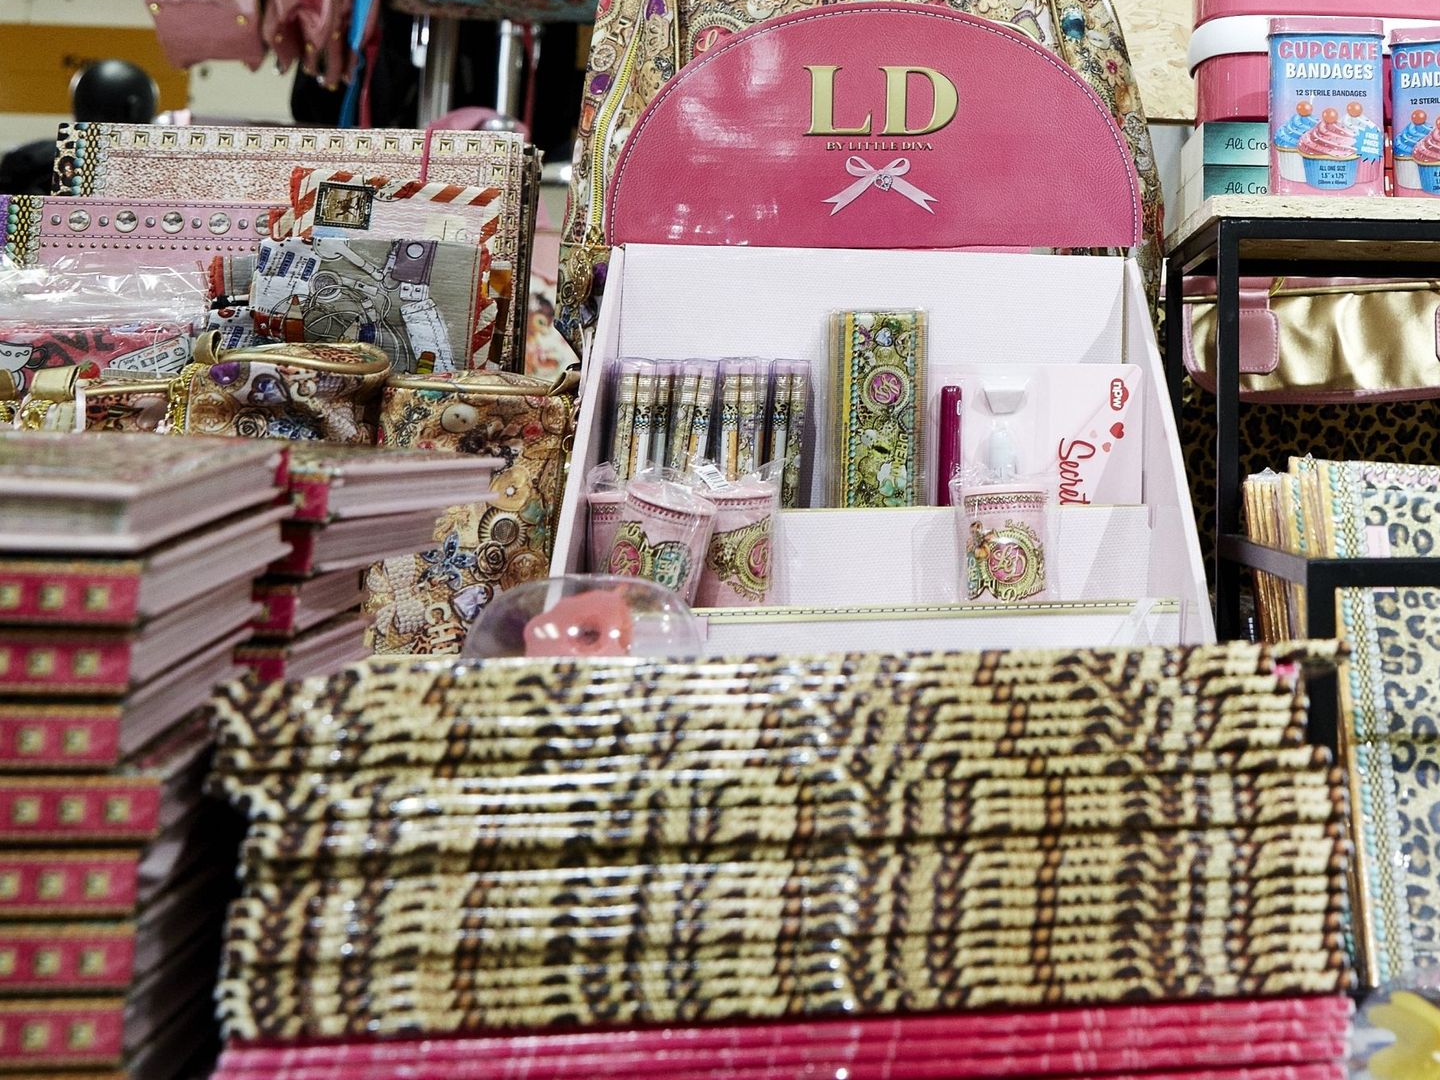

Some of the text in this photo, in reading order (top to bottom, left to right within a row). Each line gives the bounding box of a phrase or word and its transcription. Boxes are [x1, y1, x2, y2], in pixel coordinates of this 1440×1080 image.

[1278, 40, 1379, 61] CUPCAKE
[1285, 62, 1374, 80] BANDAGES
[803, 65, 959, 136] LD
[1295, 89, 1367, 98] 12 STERILE BANDAGES
[1410, 98, 1418, 106] 12
[826, 141, 933, 151] BY LITTLE DIVA
[1225, 138, 1244, 150] Ali
[1225, 182, 1244, 194] Ali
[1111, 380, 1122, 409] npw
[1058, 437, 1097, 505] Secret
